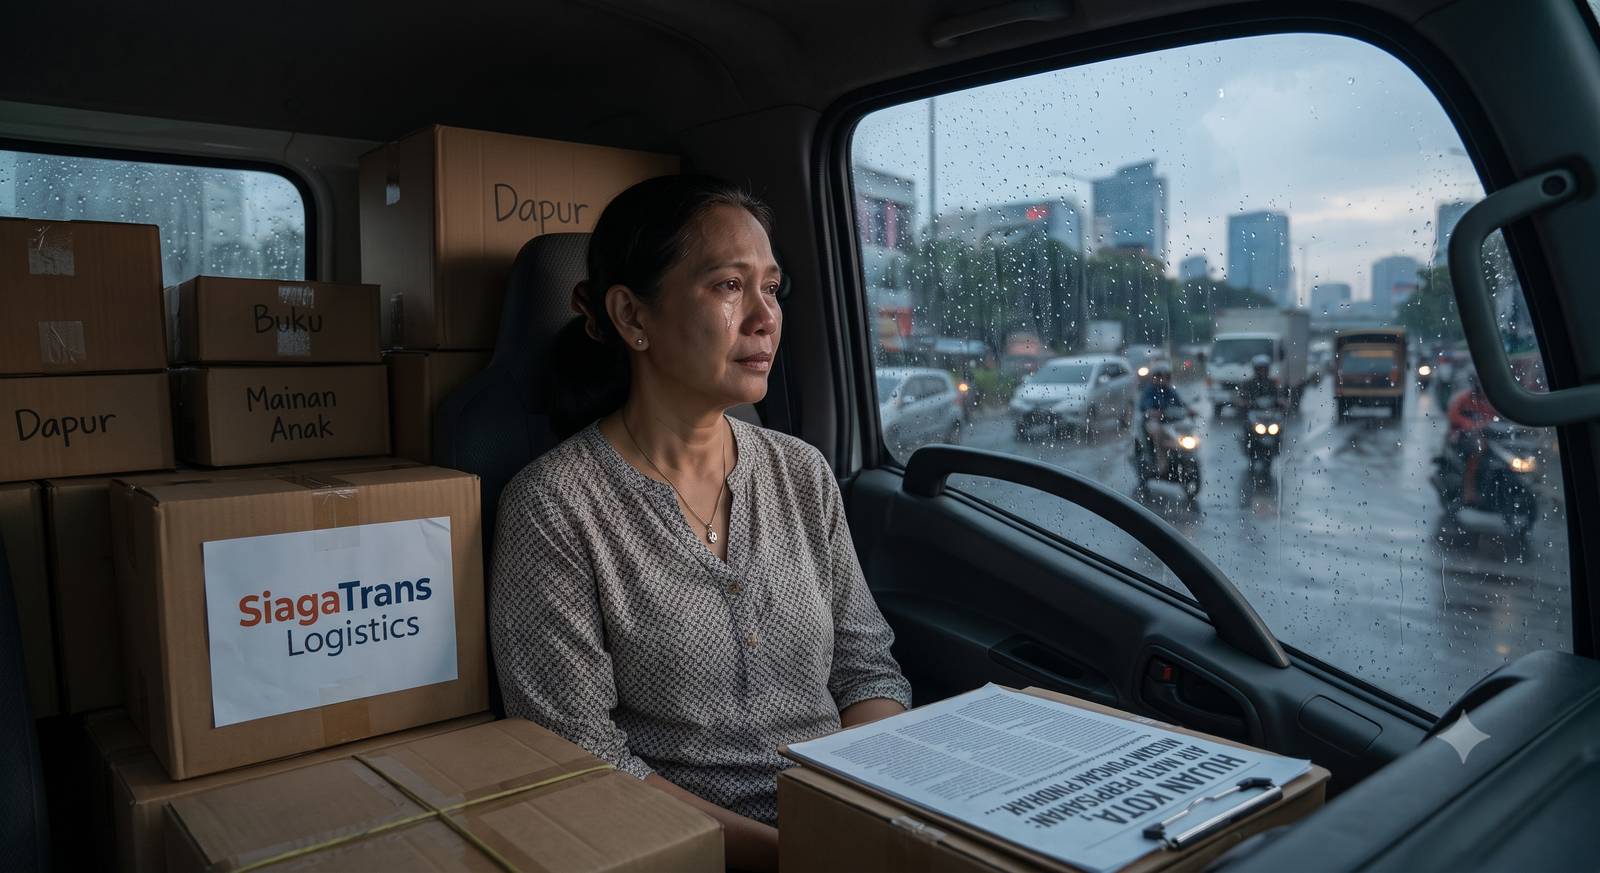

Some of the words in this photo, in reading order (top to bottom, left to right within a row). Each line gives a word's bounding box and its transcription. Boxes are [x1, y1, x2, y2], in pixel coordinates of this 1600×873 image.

[494, 183, 589, 234] Dapur
[253, 304, 323, 334] Buku
[246, 385, 337, 412] Mainan
[15, 408, 116, 447] Dapur
[270, 414, 334, 442] Anak
[239, 577, 433, 627] SiagaTrans
[287, 614, 420, 657] Logistics
[1130, 757, 1185, 780] MATA
[1172, 745, 1209, 761] AIR
[1070, 757, 1138, 786] PUNCAK
[1155, 753, 1247, 794] HUJAN
[1024, 776, 1143, 828] PERPISAHAN:
[1079, 789, 1175, 824] KOTA,
